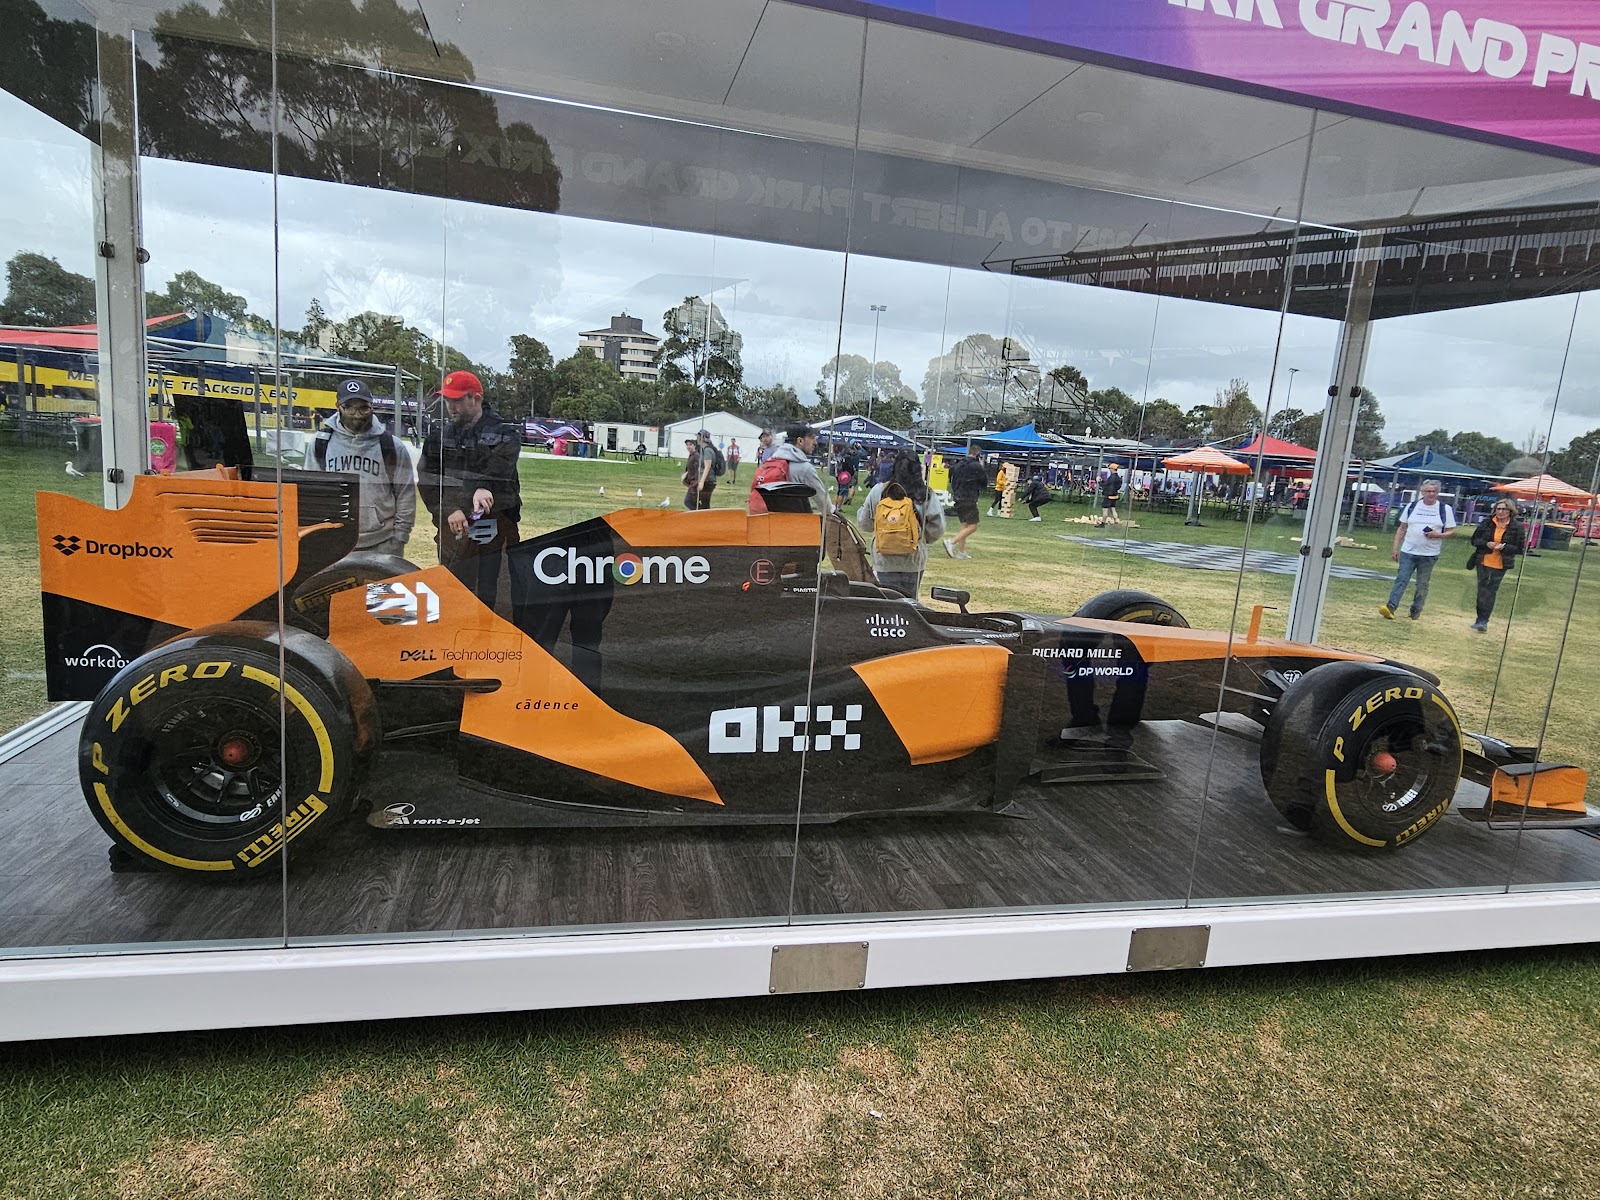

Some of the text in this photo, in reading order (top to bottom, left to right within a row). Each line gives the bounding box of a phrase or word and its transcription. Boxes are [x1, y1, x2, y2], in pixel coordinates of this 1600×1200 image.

[1299, 0, 1528, 79] GRAND
[328, 455, 380, 477] ELWOOD
[85, 540, 174, 560] Dropbox
[533, 547, 711, 586] Chrome
[400, 648, 523, 664] DELL Technologies
[1032, 648, 1123, 659] RICHARD MILLE
[1078, 666, 1134, 677] DP WORLD
[92, 661, 232, 775] P ZERO
[1333, 687, 1424, 763] P ZERO
[236, 793, 329, 868] PIRELLI
[413, 817, 481, 826] rent-a-jet
[1395, 797, 1449, 847] PIRELLI
